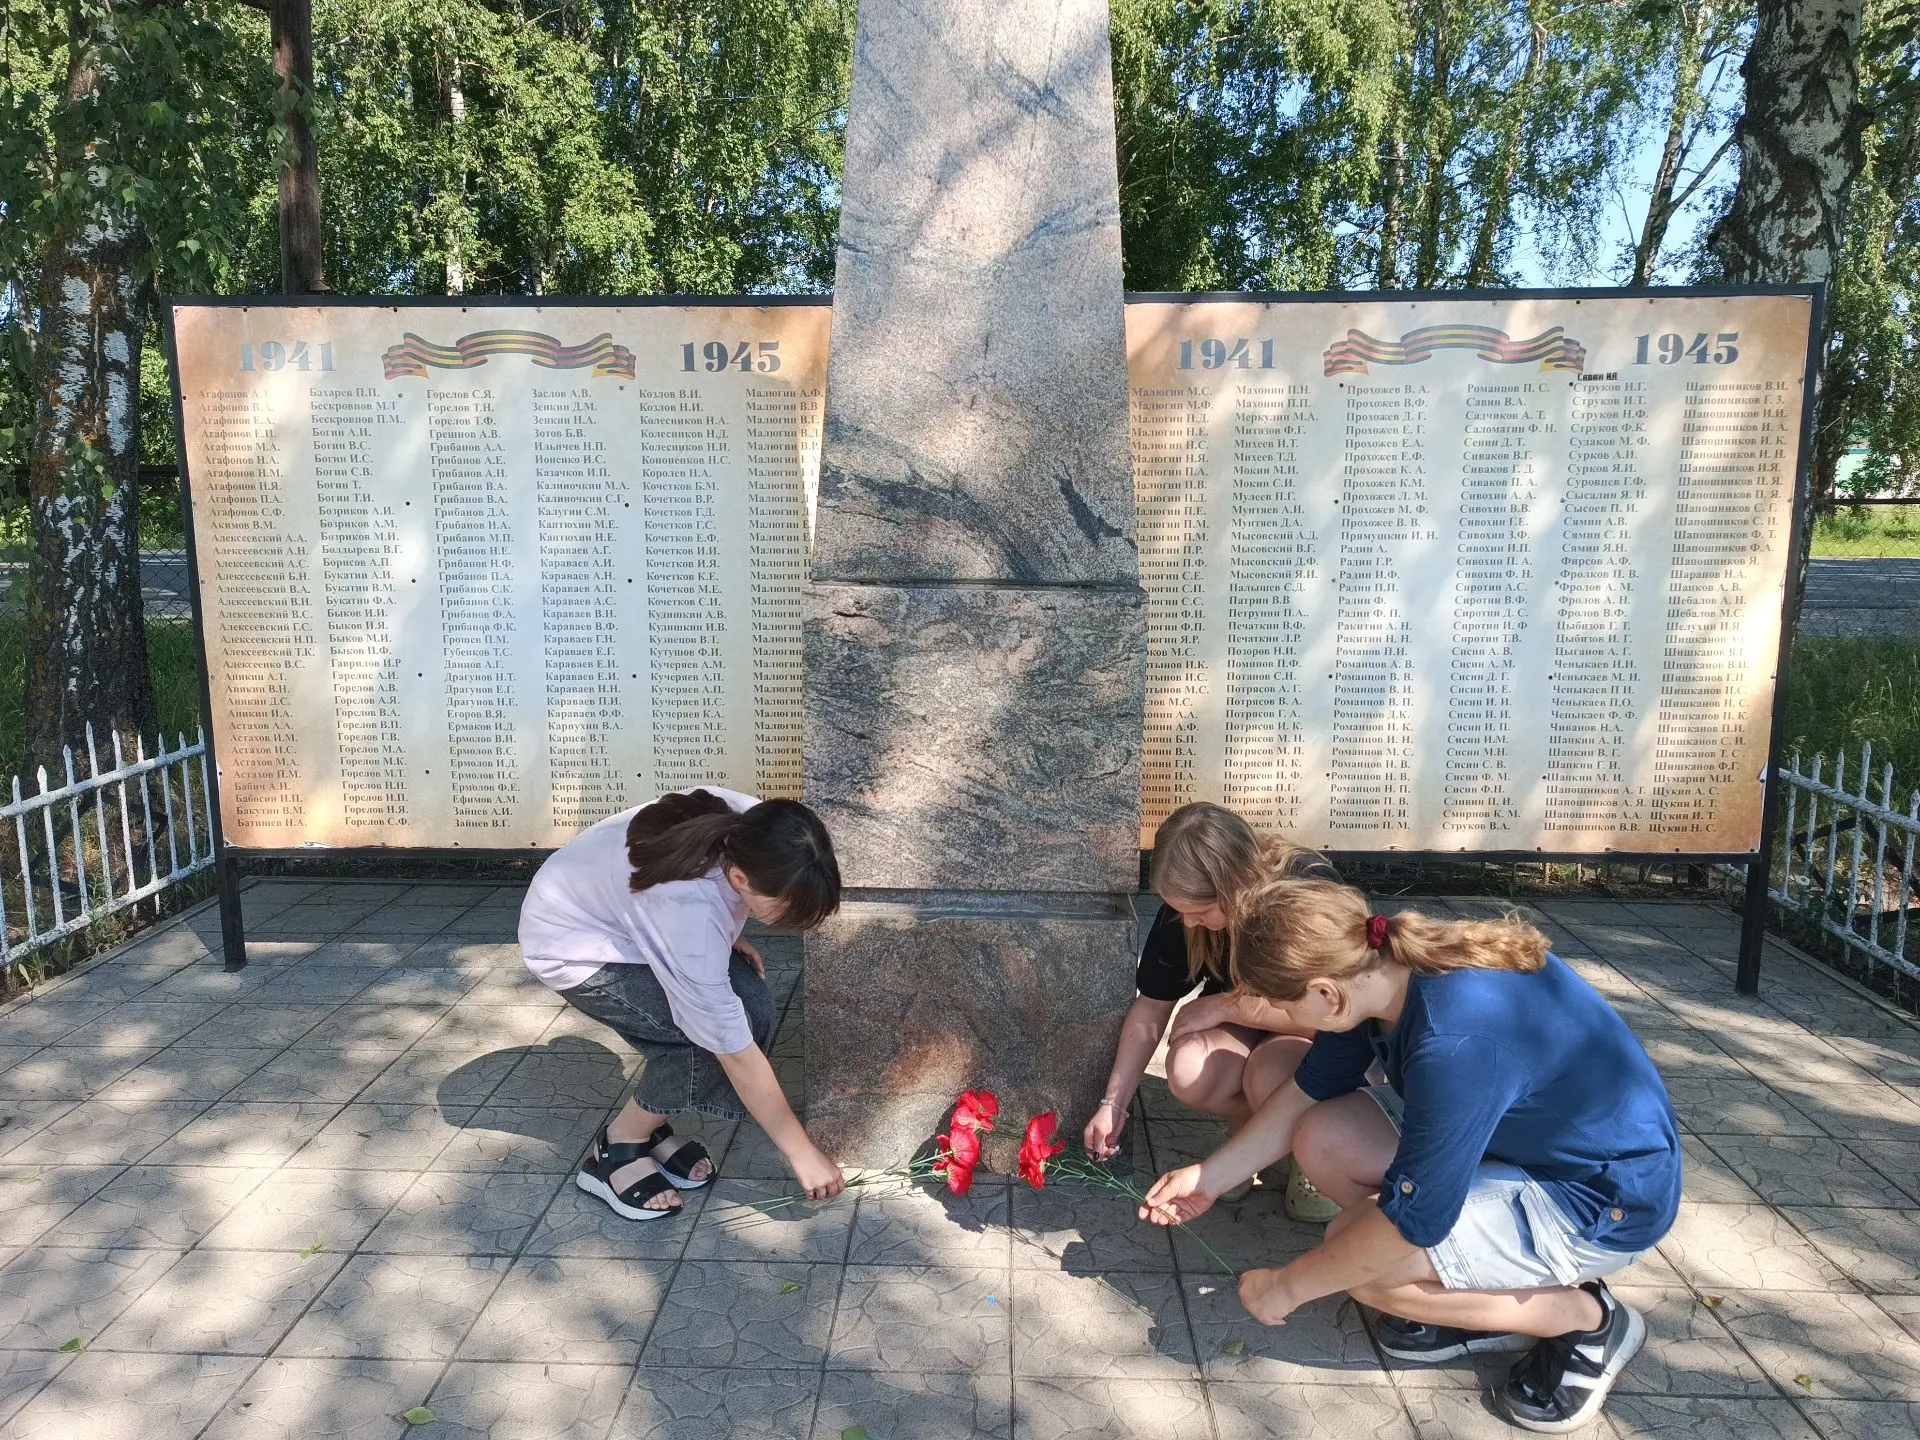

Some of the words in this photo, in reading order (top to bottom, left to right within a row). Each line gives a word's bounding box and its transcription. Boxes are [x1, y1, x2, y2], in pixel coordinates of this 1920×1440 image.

[1177, 338, 1276, 370] 1941
[1632, 332, 1739, 366] 1945
[239, 340, 336, 372] 1941
[680, 341, 781, 372] 1945
[1686, 381, 1762, 392] Шапошников
[310, 388, 353, 399] Бахарев
[427, 389, 469, 401] Горелов
[531, 389, 567, 398] Заслов
[746, 388, 796, 398] Малюгин
[1131, 387, 1184, 398] Малюгин
[531, 402, 570, 411] Зенкин
[1347, 398, 1400, 410] Прохожев
[1466, 397, 1501, 407] Савин
[533, 428, 562, 438] Зотов
[1570, 423, 1618, 435] Струков
[201, 442, 253, 455] Агафонов
[313, 440, 345, 450] Богин
[430, 442, 481, 454] Грибанов
[1345, 438, 1398, 451] Прохожев
[1234, 452, 1274, 462] Михеев
[1463, 450, 1509, 461] Сиваков
[316, 480, 348, 489] Богин
[1566, 476, 1620, 489] Суровцев
[643, 494, 692, 504] Кочетков
[209, 507, 259, 519] Агафонов
[538, 507, 582, 518] Калугин
[644, 507, 693, 517] Кочетков
[210, 520, 250, 530] Акимов
[320, 519, 369, 531] Бозриков
[212, 534, 282, 543] Алексеевский
[645, 533, 694, 543] Кочетков
[540, 545, 589, 557] Караваев
[1231, 544, 1293, 553] Мысовский
[1340, 544, 1373, 555] Радин
[323, 557, 366, 569] Борисов
[1340, 557, 1372, 568] Радин
[1561, 556, 1603, 568] Фирсов
[647, 572, 695, 581] Кочетков
[325, 583, 368, 594] Букатин
[440, 584, 488, 596] Грибанов
[1455, 582, 1502, 594] Сиротин
[542, 596, 591, 608] Караваев
[1557, 608, 1599, 620] Фролов
[1229, 621, 1279, 630] Печаткин
[649, 635, 697, 646] Кузнецов
[222, 648, 292, 657] Алексеевский
[545, 647, 593, 658] Караваев
[650, 660, 698, 671] Кучеряев
[224, 672, 264, 682] Аникин
[334, 683, 374, 694] Горелов
[445, 685, 494, 696] Драгунов
[447, 709, 482, 720] Егоров
[549, 733, 586, 745] Карцев
[450, 746, 493, 757] Ермолов
[232, 757, 273, 767] Астахов
[340, 757, 380, 768] Горелов
[1655, 762, 1715, 771] Шишканов
[1654, 774, 1706, 785] Шумарин
[453, 795, 492, 806] Ефимов
[552, 794, 603, 805] Кирьяков
[345, 817, 385, 828] Горелов
[454, 819, 489, 830] Зайцев
[1442, 821, 1486, 832] Струков
[1544, 822, 1616, 831] Шапошников
